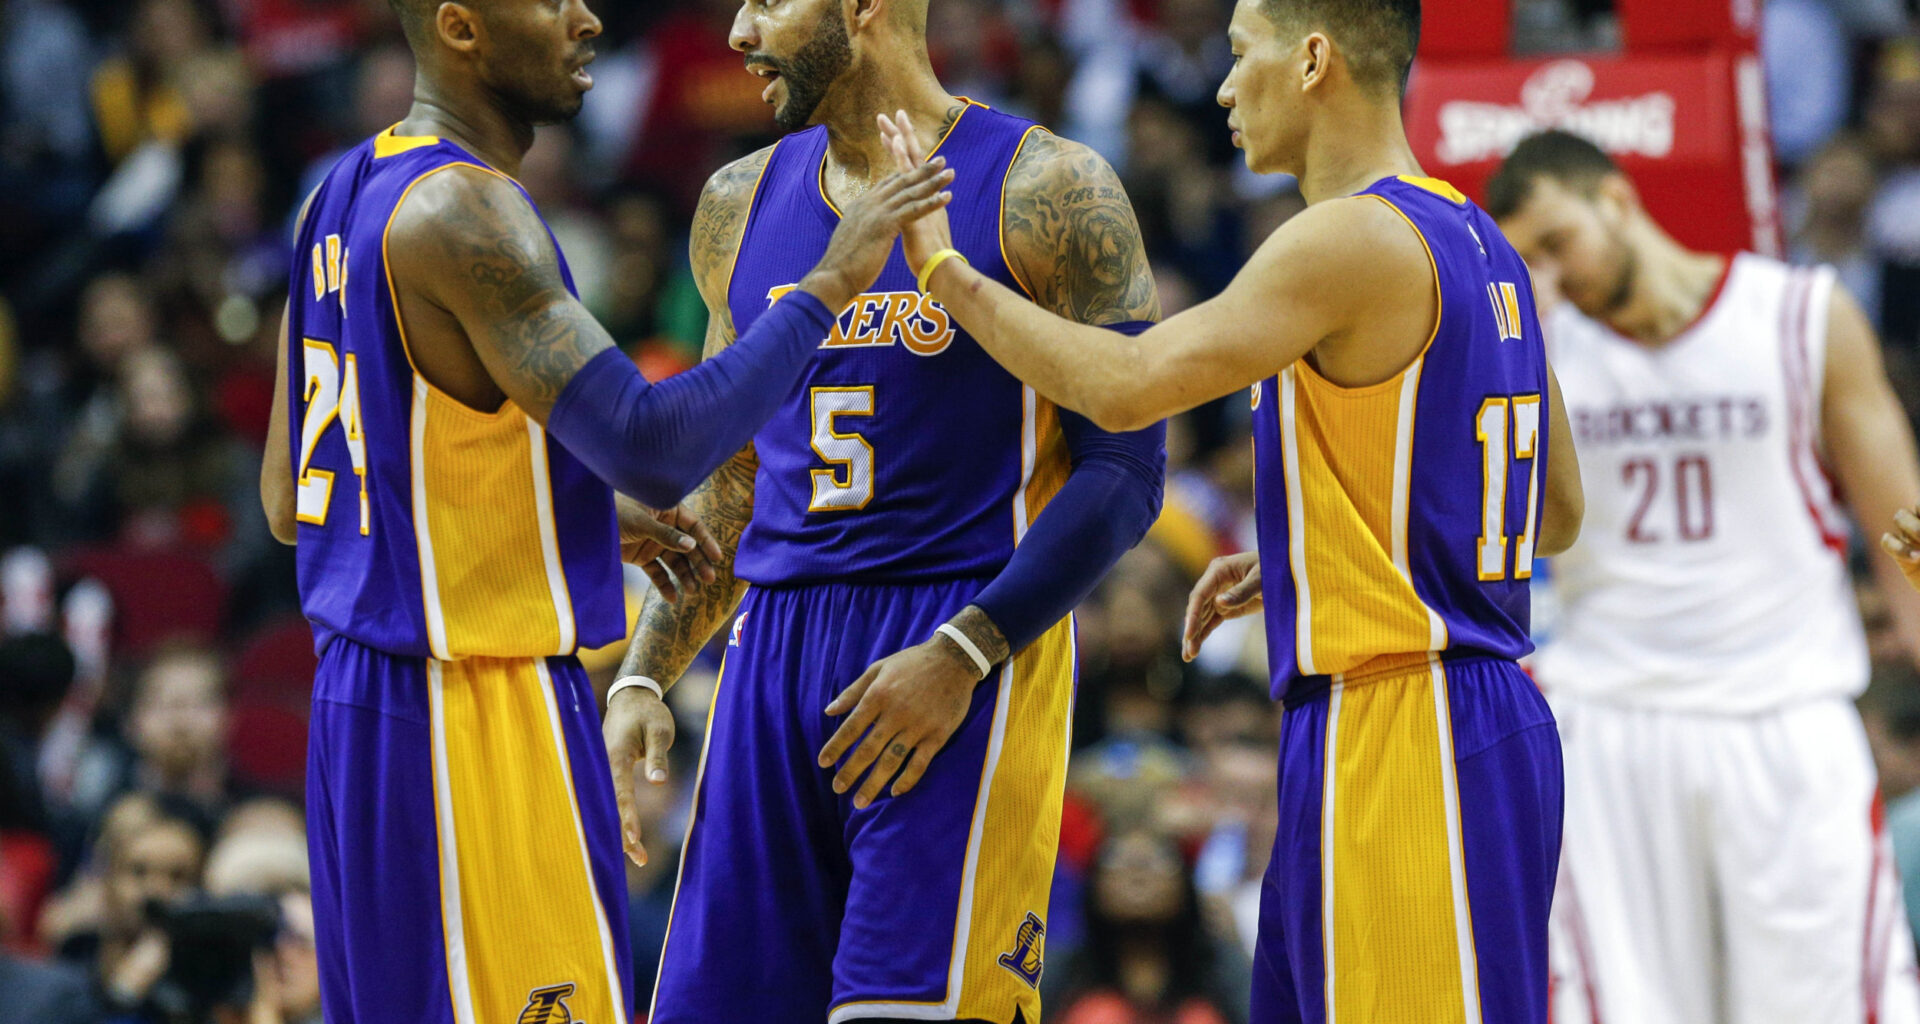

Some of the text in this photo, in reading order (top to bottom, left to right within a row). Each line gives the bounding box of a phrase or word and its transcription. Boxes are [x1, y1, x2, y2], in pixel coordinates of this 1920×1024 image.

[296, 337, 370, 536] 24
[808, 385, 874, 512] 5
[1476, 394, 1541, 581] 17
[1621, 453, 1714, 544] 20
